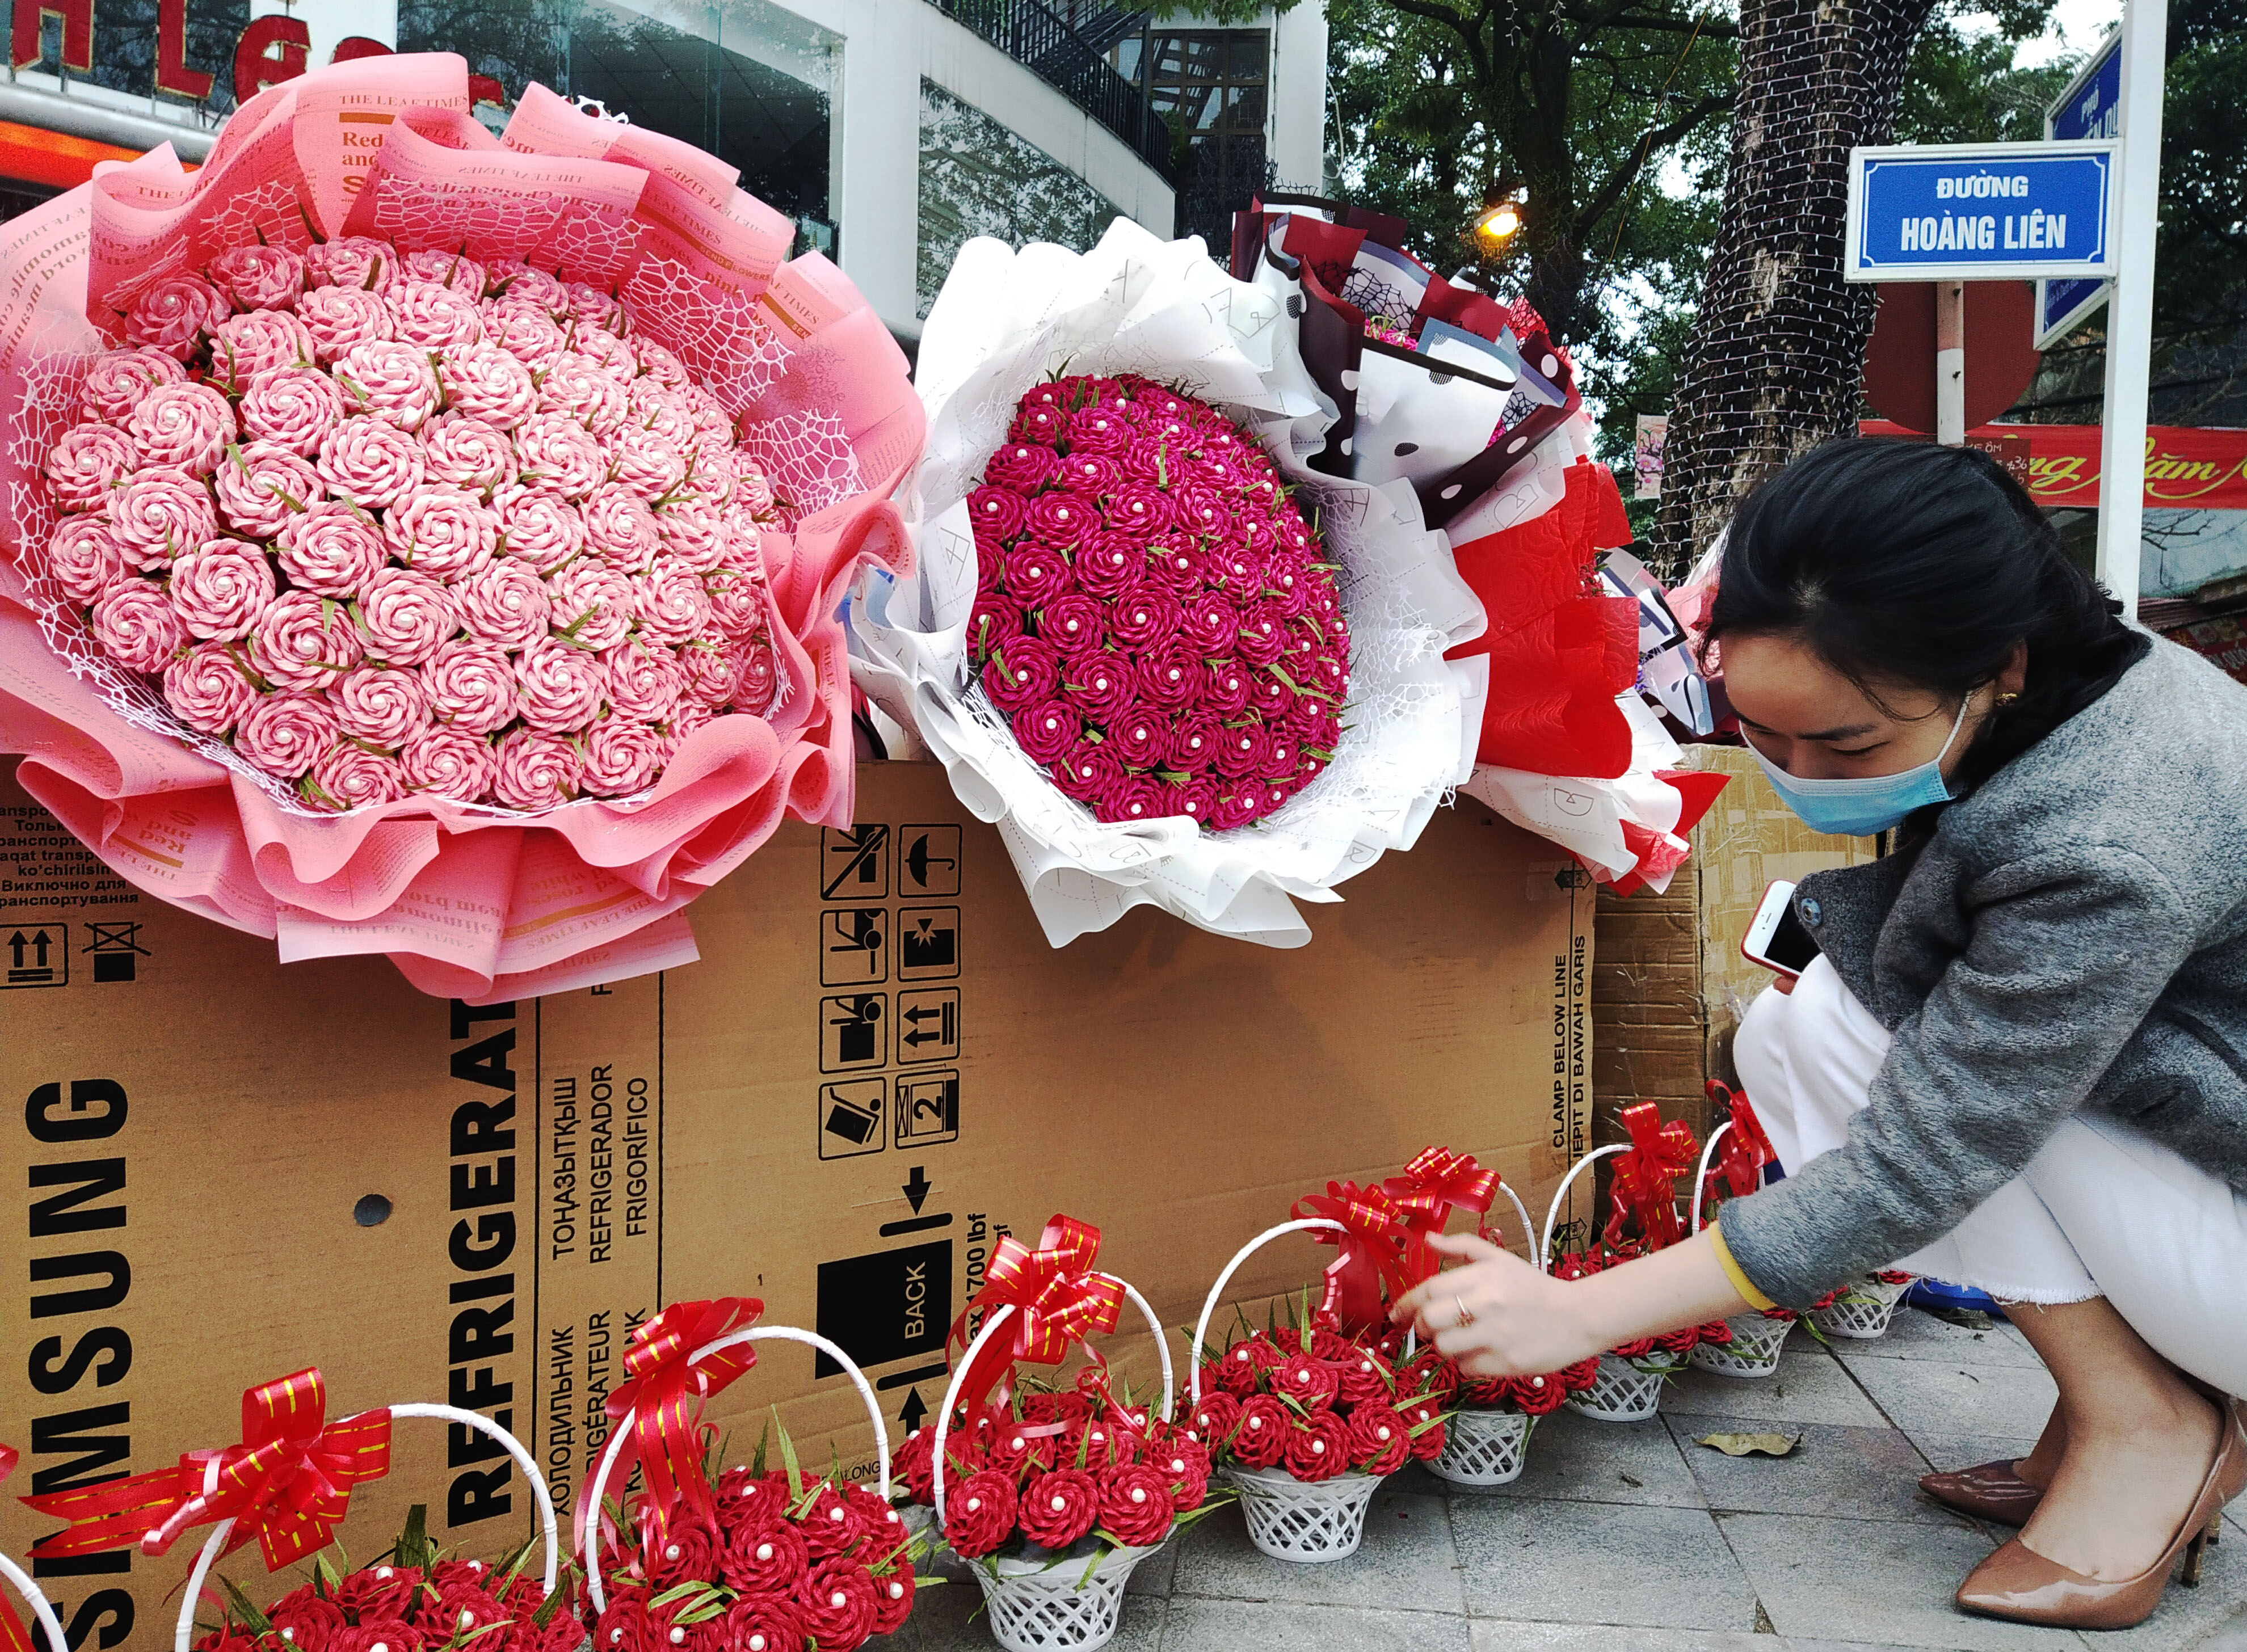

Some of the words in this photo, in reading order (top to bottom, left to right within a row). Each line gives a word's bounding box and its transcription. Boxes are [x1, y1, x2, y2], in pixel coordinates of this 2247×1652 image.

[339, 94, 372, 105] THE
[342, 132, 384, 148] Red
[1935, 168, 2030, 199] ĐƯỜNG
[1900, 209, 1996, 251] HOÀNG
[2004, 208, 2067, 250] LIÊN
[784, 285, 820, 325] TIMES
[0, 807, 53, 819] anspo
[14, 819, 66, 832] Тольк
[0, 836, 83, 849] ранспорт
[0, 852, 37, 863] aqat
[2, 879, 90, 892] Виключно
[94, 879, 127, 892] для
[1555, 955, 1567, 998] LINE
[1573, 934, 1585, 997] GARIS
[1554, 1004, 1566, 1074] BELOW
[1573, 1002, 1584, 1076] BAWAH
[913, 1095, 942, 1120] 2
[1573, 1083, 1584, 1102] DI
[1553, 1080, 1566, 1149] CLAMP
[1573, 1108, 1584, 1159] JEPIT
[590, 1063, 613, 1263] REFRIGERADOR
[622, 1076, 648, 1238] FRIGORÍFICO
[966, 1213, 987, 1243] lbf
[447, 997, 517, 1529] REFRIGERAT
[904, 1261, 927, 1340] BACK
[549, 1324, 576, 1518] ХОЛОДИЛЬНИК
